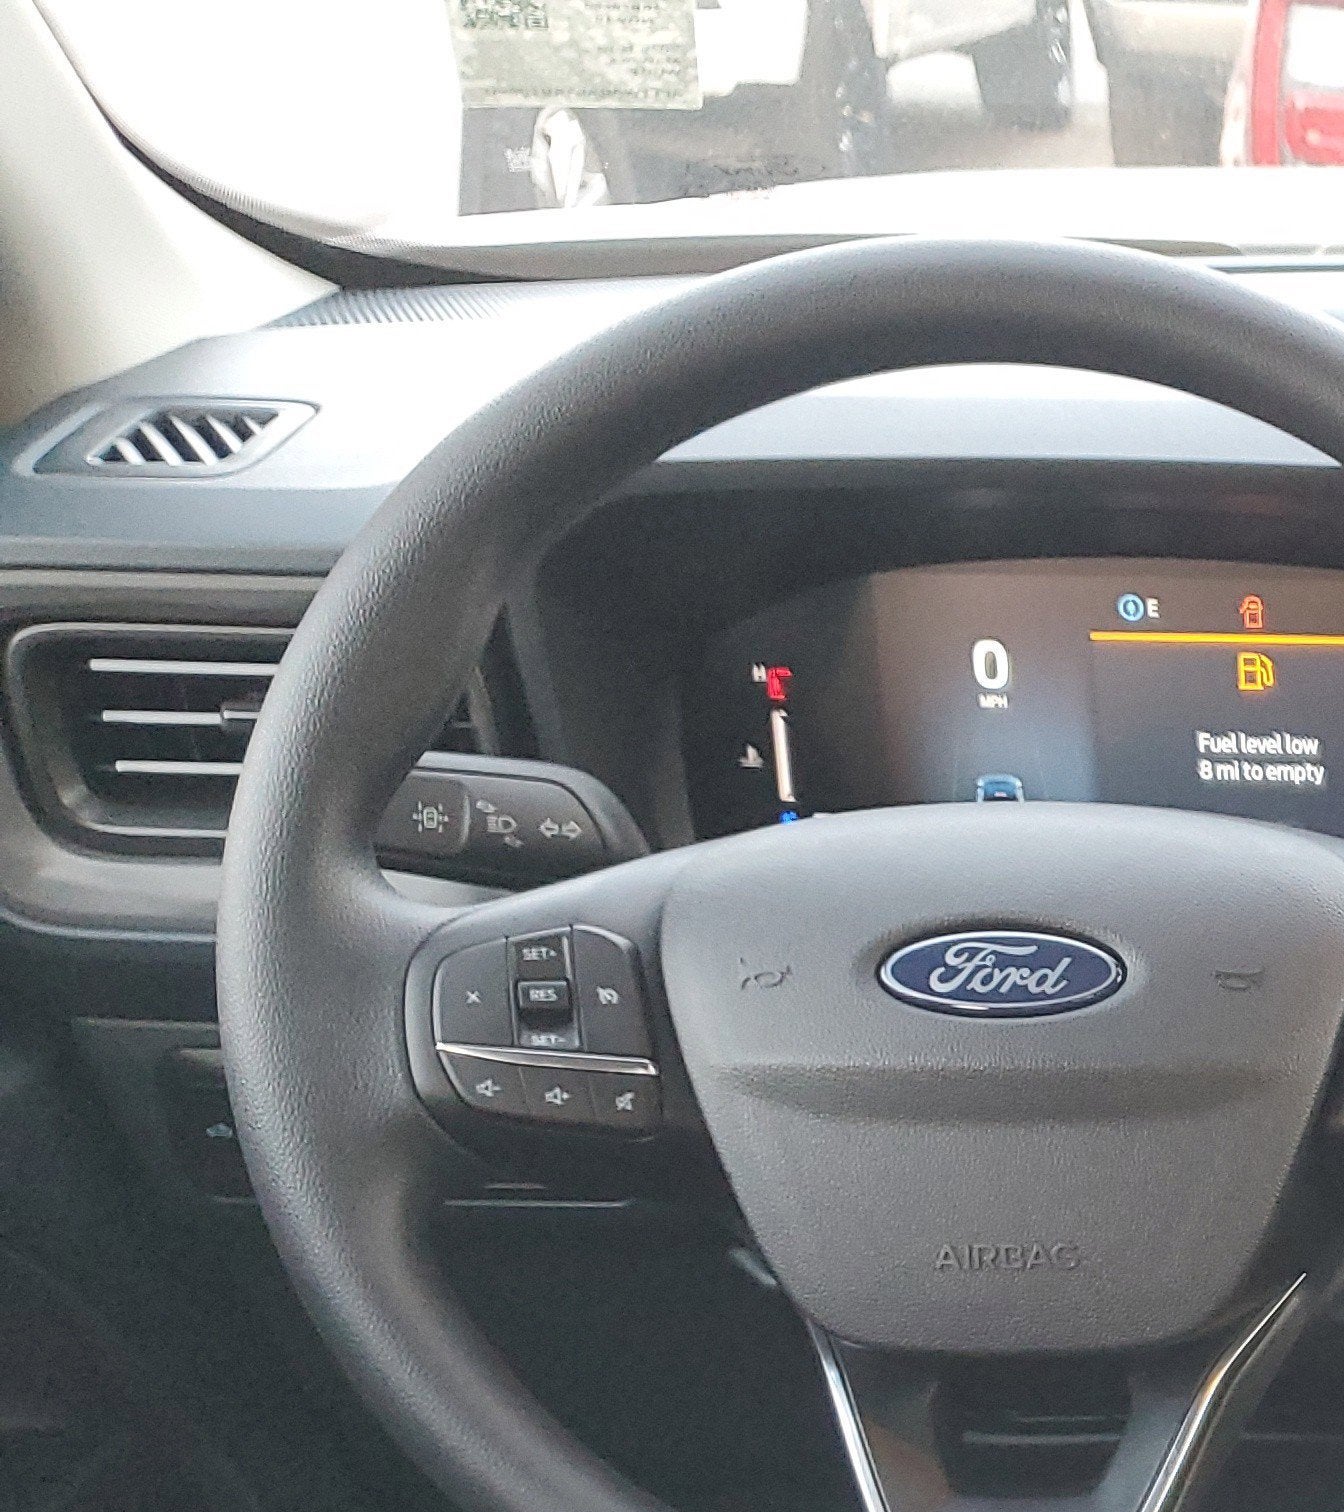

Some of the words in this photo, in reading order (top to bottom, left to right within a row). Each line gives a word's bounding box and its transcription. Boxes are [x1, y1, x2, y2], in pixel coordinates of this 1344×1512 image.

[971, 638, 1009, 690] 0
[1197, 731, 1238, 755] Fuel
[1240, 731, 1285, 756] level
[1286, 732, 1319, 756] low
[1199, 760, 1213, 781] 8
[1216, 760, 1240, 781] mi
[1242, 762, 1264, 782] to
[1265, 764, 1325, 786] empty
[928, 940, 1074, 996] Ford
[934, 1241, 1081, 1272] AIRBAG
